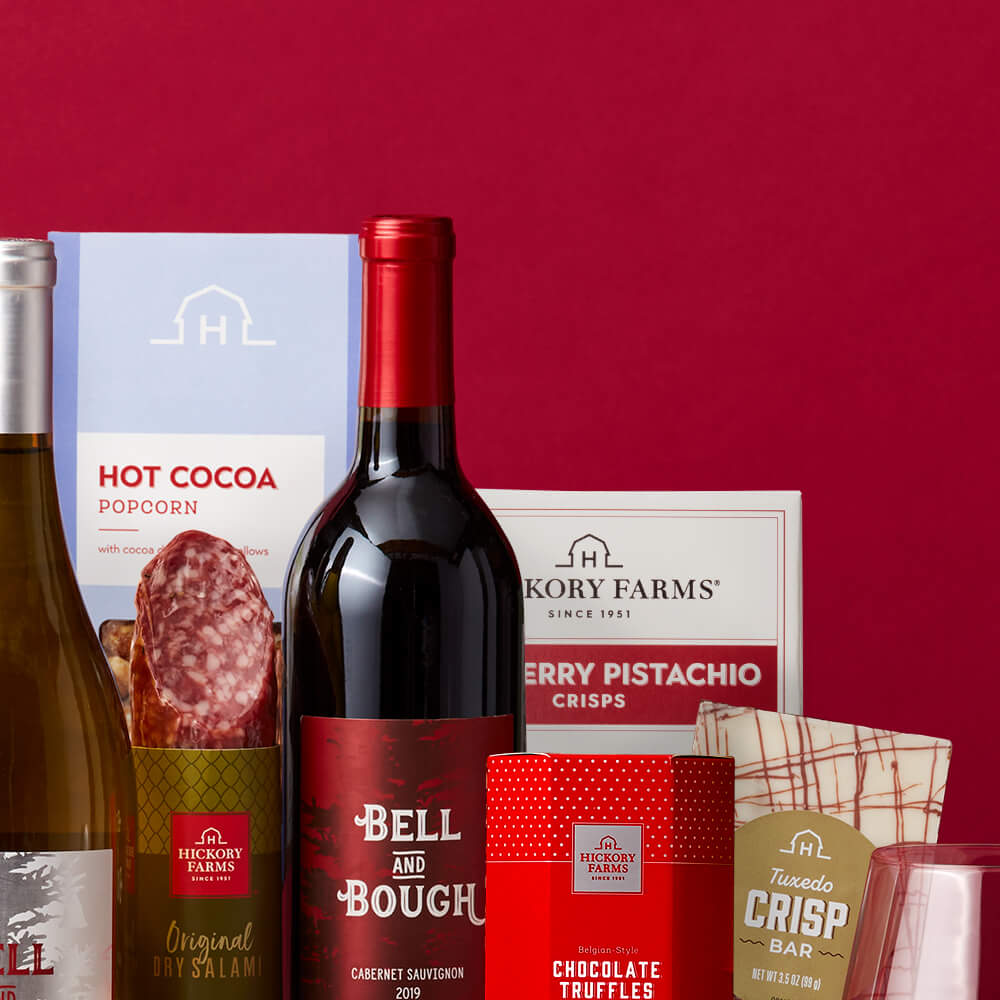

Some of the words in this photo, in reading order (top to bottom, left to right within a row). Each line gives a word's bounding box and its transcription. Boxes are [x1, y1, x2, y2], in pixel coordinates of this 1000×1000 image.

[99, 465, 161, 488] HOT
[170, 465, 278, 489] COCOA
[98, 499, 198, 514] POPCORN
[98, 544, 119, 554] with
[122, 545, 154, 554] cocoa
[548, 609, 593, 618] SINCE
[601, 609, 631, 618] 1951
[604, 662, 761, 686] PISTACHIO
[552, 693, 626, 708] CRISPS
[354, 804, 462, 842] BELL
[178, 848, 243, 860] HICKORY
[580, 853, 636, 863] HICKORY
[187, 861, 235, 872] FARMS
[392, 856, 426, 874] AND
[588, 864, 629, 873] FARMS
[769, 867, 834, 894] Tuxedo
[336, 879, 486, 926] BOUGH
[744, 889, 849, 940] CRISP
[167, 920, 256, 964] Original
[578, 945, 639, 955] Belgian-Style
[769, 938, 814, 959] BAR
[153, 955, 185, 978] DRY
[191, 954, 262, 979] SALAMI
[351, 968, 403, 980] CABERNET
[407, 967, 464, 980] SAUVIGNON
[552, 960, 661, 979] CHOCOLATE
[751, 968, 766, 981] NET
[766, 970, 778, 983] WT
[778, 972, 790, 984] 3.5
[790, 974, 800, 986] OZ
[396, 986, 421, 1000] 2019
[559, 982, 654, 1000] TRUFFLES
